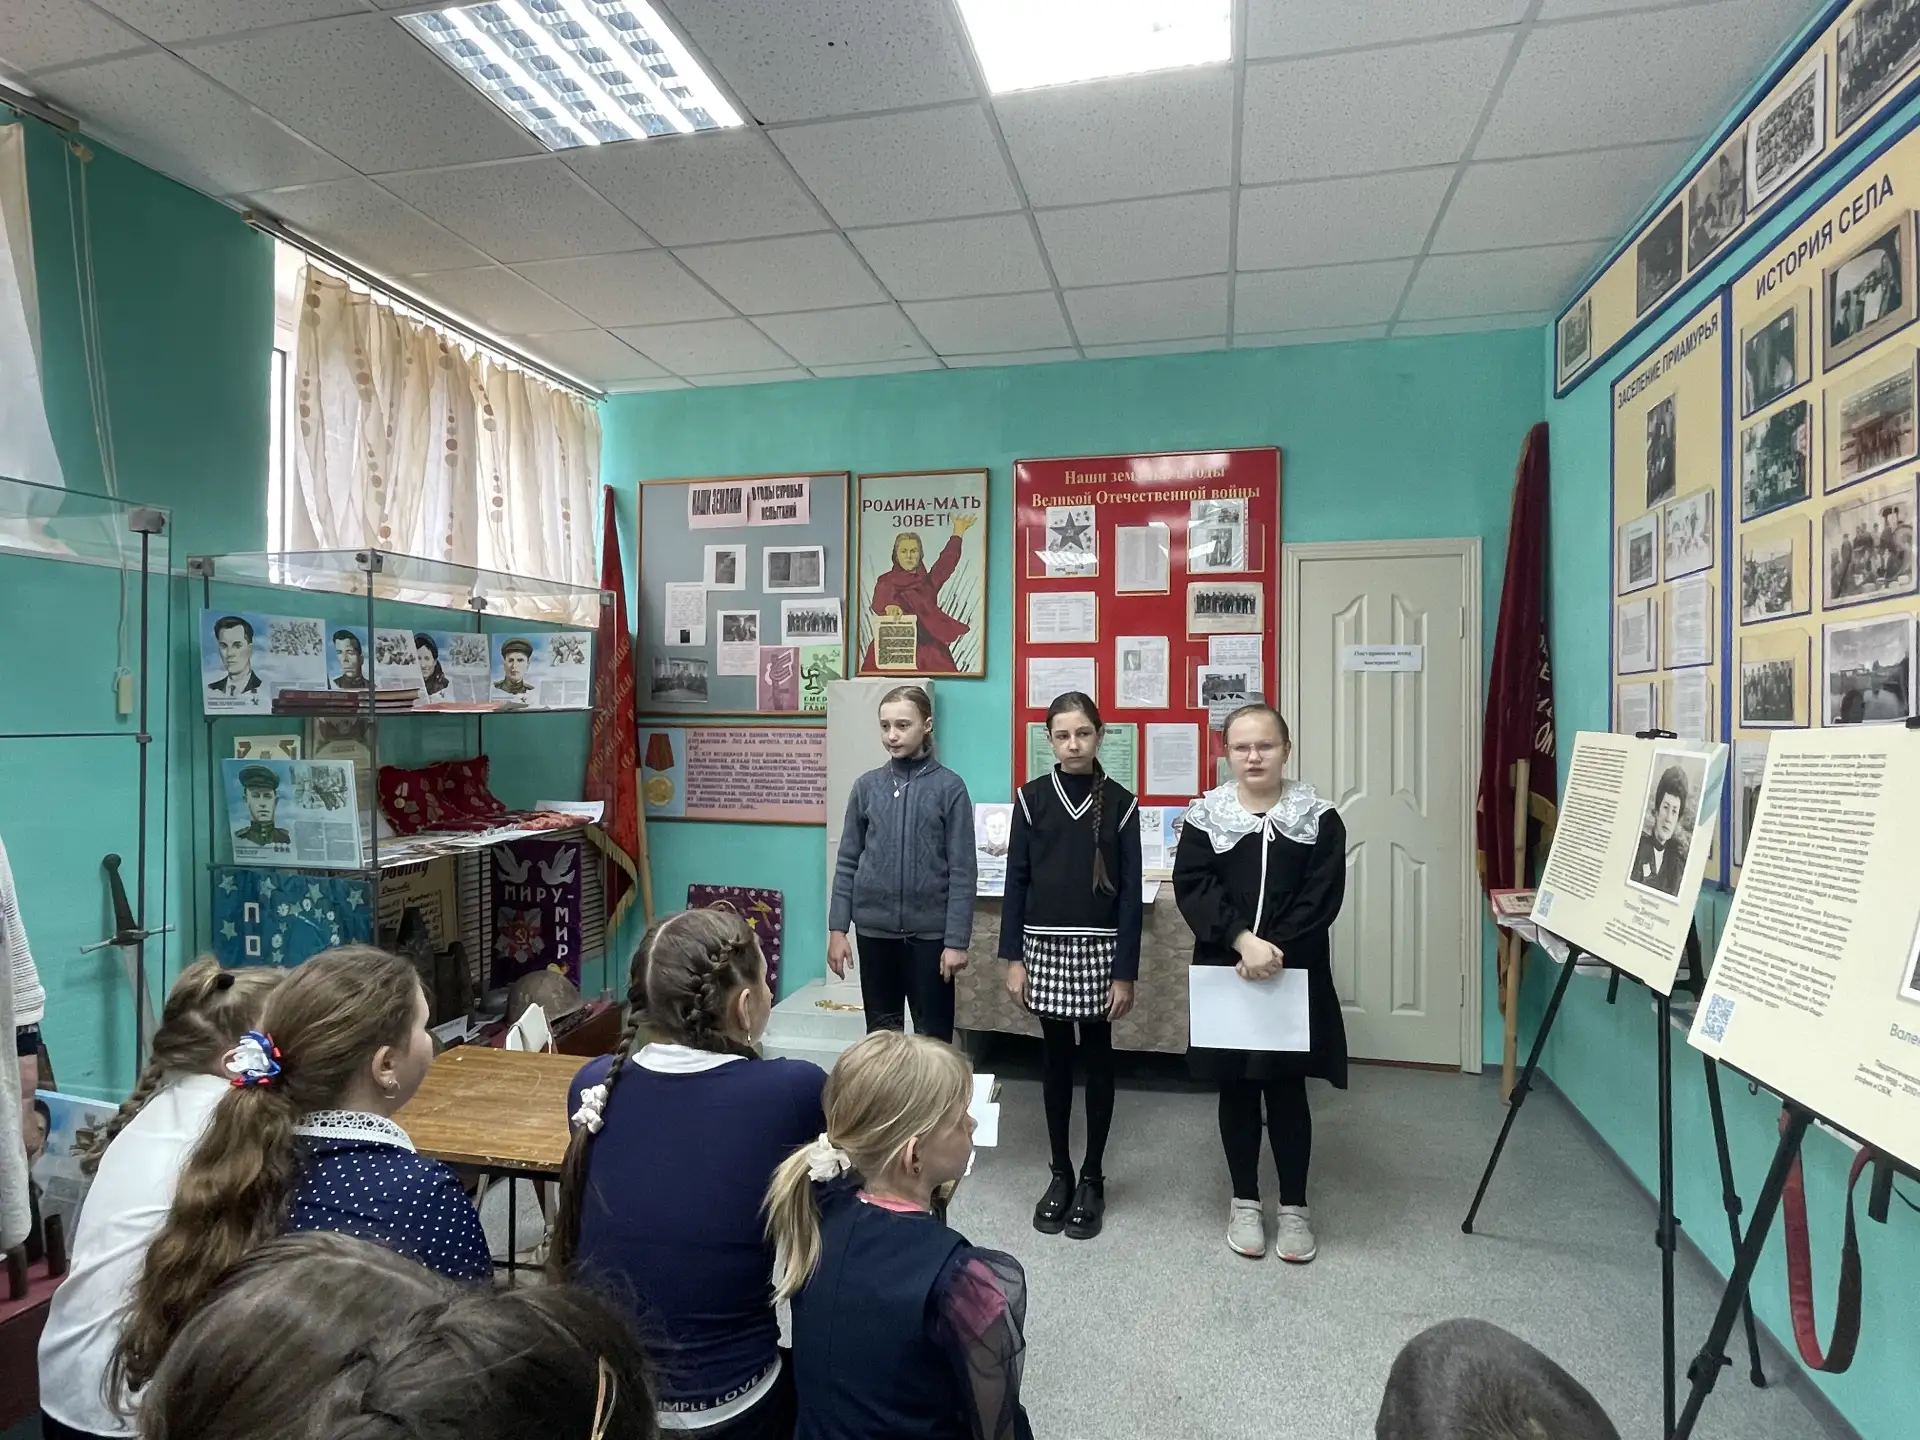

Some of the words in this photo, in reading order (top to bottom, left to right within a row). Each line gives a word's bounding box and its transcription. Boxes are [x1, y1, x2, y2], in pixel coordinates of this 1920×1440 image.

[1756, 220, 1833, 300] ИСТОРИЯ
[1838, 174, 1894, 234] СЕЛА
[1617, 363, 1661, 409] ЗАСЕЛЕНИЕ
[1662, 311, 1718, 374] ПРИАМУРЬЯ
[1065, 470, 1107, 485] Наши
[757, 485, 775, 502] ГОДЫ
[775, 483, 804, 500] СУРОВЫХ
[1032, 491, 1092, 508] Великой
[1096, 484, 1206, 505] Отечественной
[1211, 486, 1260, 500] войны
[862, 496, 982, 513] РОДИНА-МАТЬ
[892, 513, 951, 528] ЗОВЕТ!
[504, 883, 574, 903] МИРУ-
[554, 906, 569, 960] МИР
[657, 1401, 707, 1412] IMPLE
